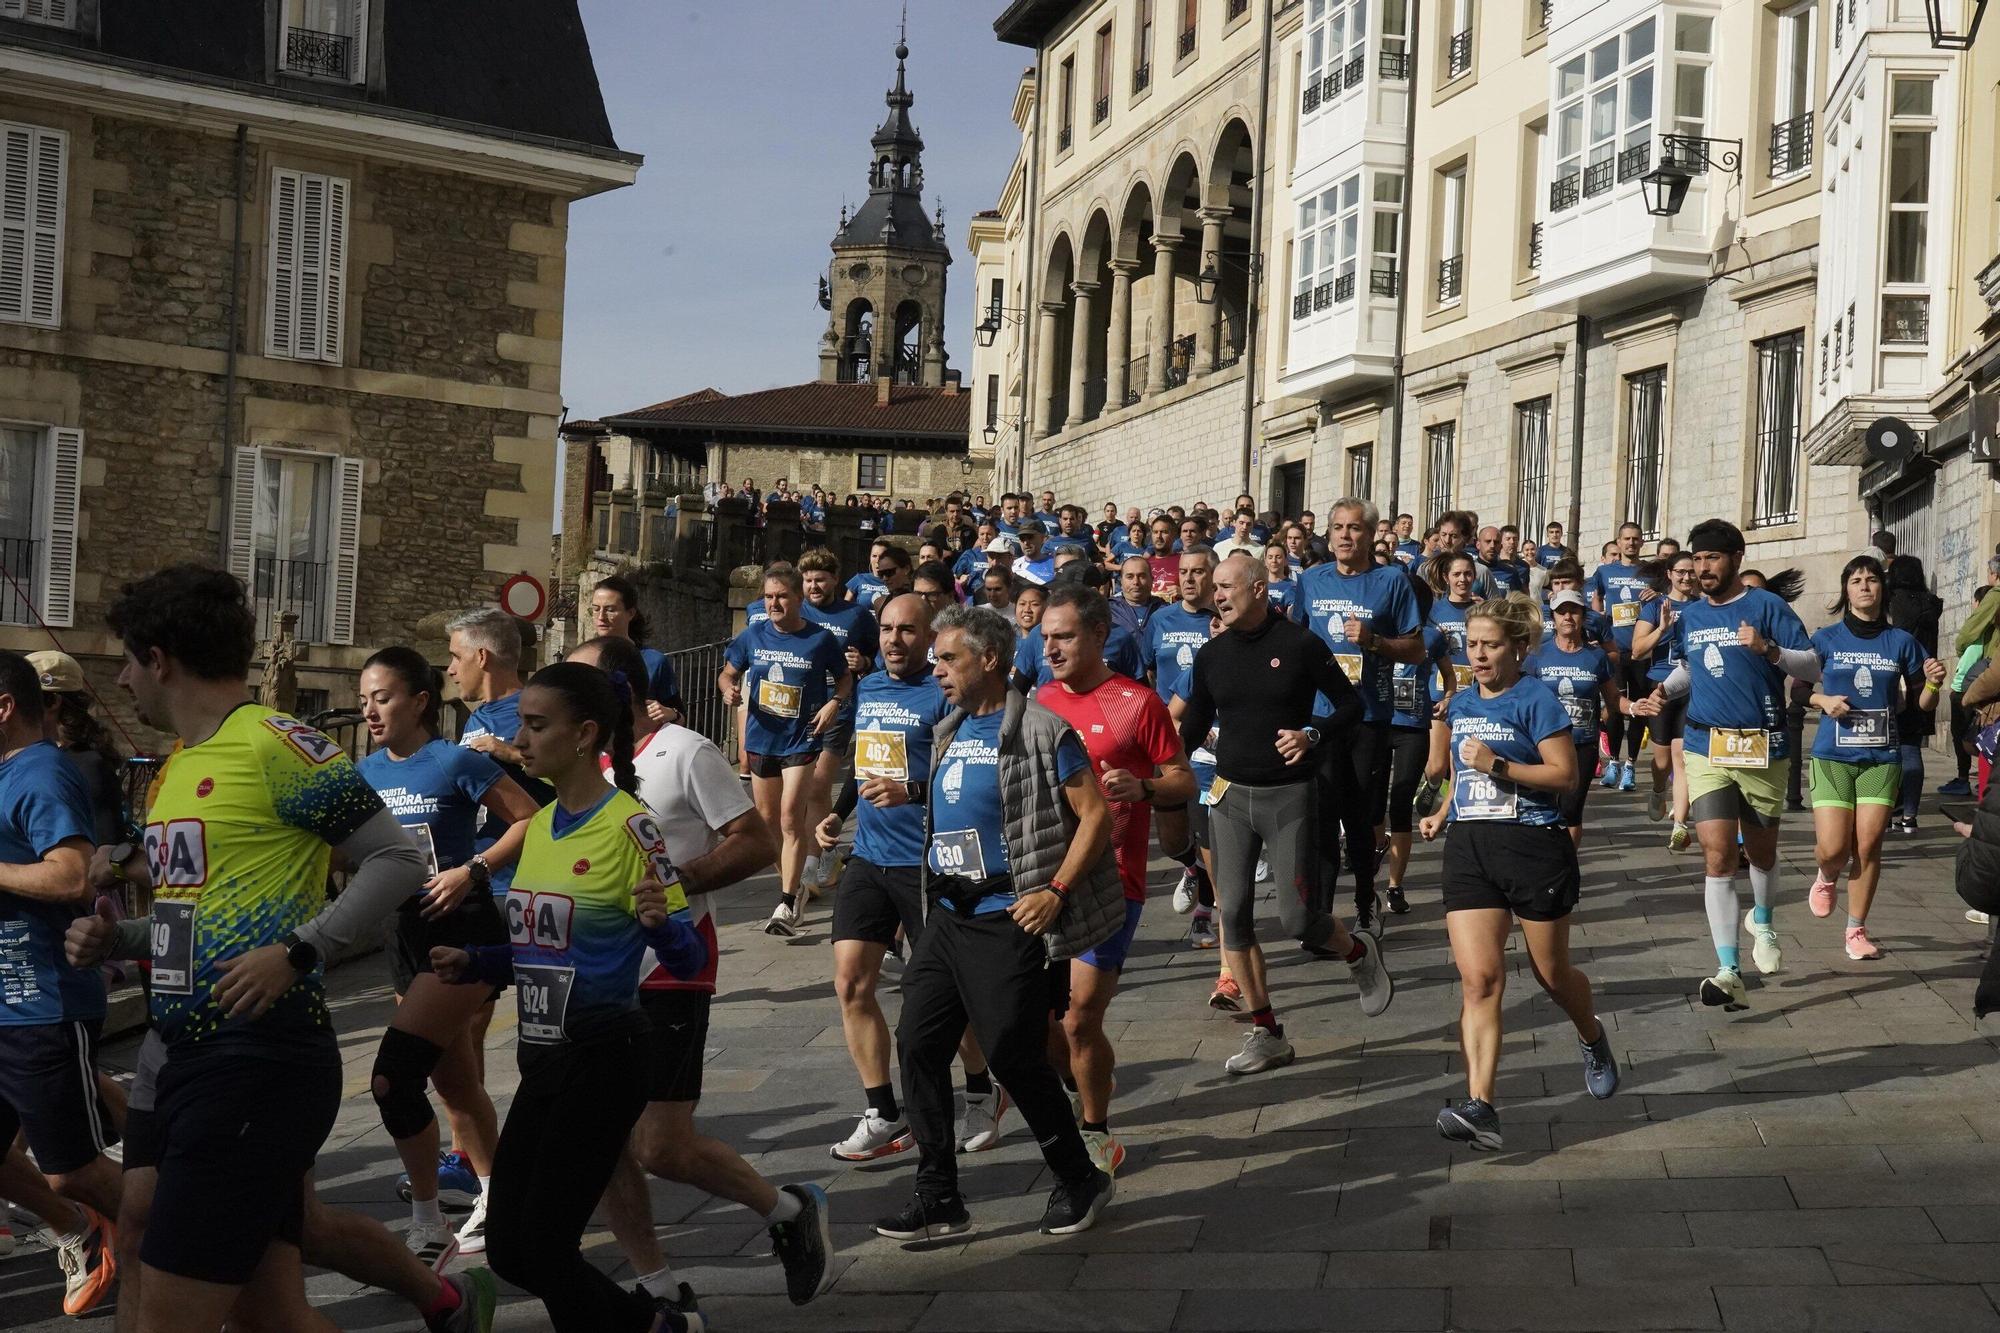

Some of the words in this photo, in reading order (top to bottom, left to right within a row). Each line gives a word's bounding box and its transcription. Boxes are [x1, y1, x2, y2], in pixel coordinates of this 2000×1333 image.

[1620, 608, 1634, 617] 301
[1694, 627, 1728, 636] CONQUISTA
[761, 655, 805, 663] ALMENDRA
[1843, 657, 1894, 666] ALMENDRA
[769, 690, 790, 705] 340
[861, 708, 909, 717] ALMENDRA
[882, 717, 920, 727] KONKISTA
[1852, 719, 1875, 732] 738
[1727, 736, 1753, 753] 612
[866, 744, 891, 762] 462
[945, 747, 998, 757] ALMENDRA
[392, 804, 439, 815] KONKISTA
[936, 845, 964, 867] 830
[180, 910, 190, 918] 5K
[559, 974, 569, 982] 5K
[522, 984, 549, 1014] 924
